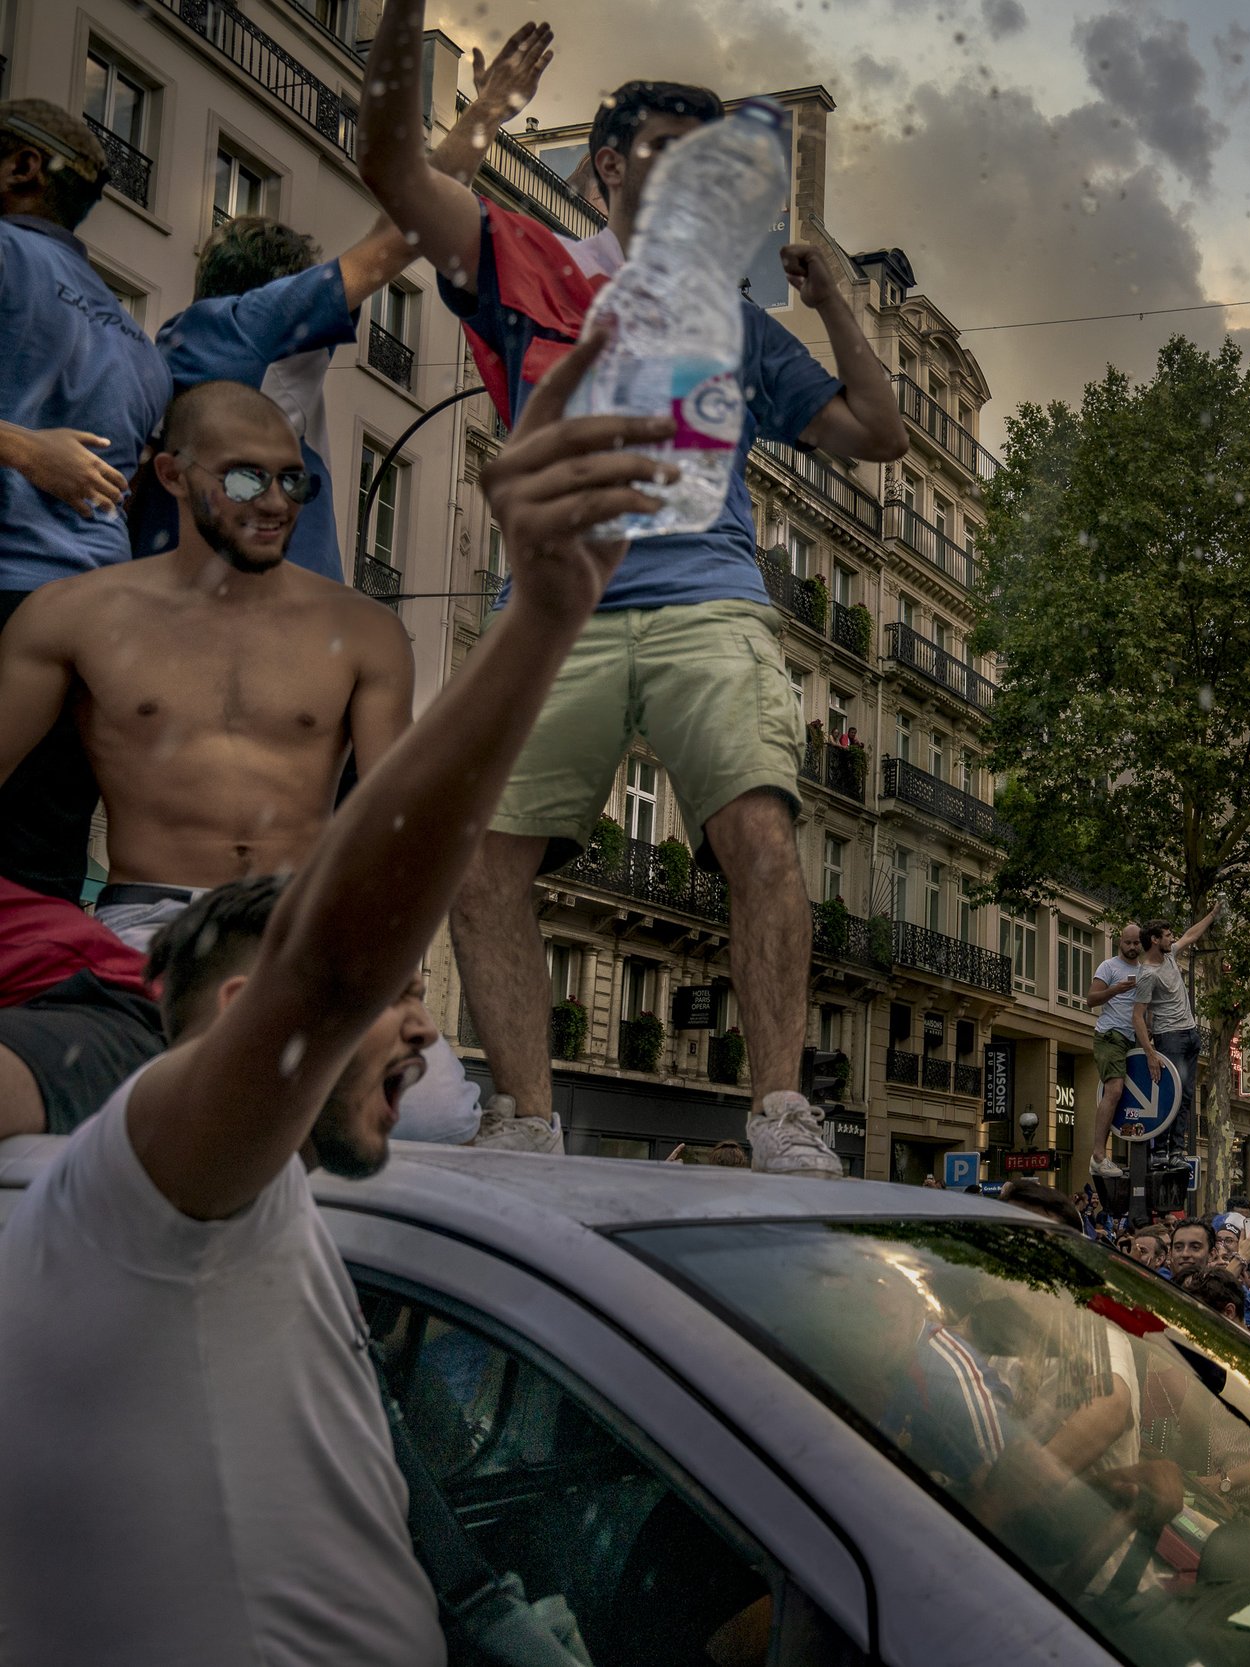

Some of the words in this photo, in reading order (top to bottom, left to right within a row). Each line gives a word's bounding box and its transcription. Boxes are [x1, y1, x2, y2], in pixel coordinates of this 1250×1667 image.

[987, 1051, 994, 1066] DU
[995, 1051, 1007, 1114] MAISONS
[1008, 1156, 1047, 1168] METRO
[954, 1161, 969, 1181] P
